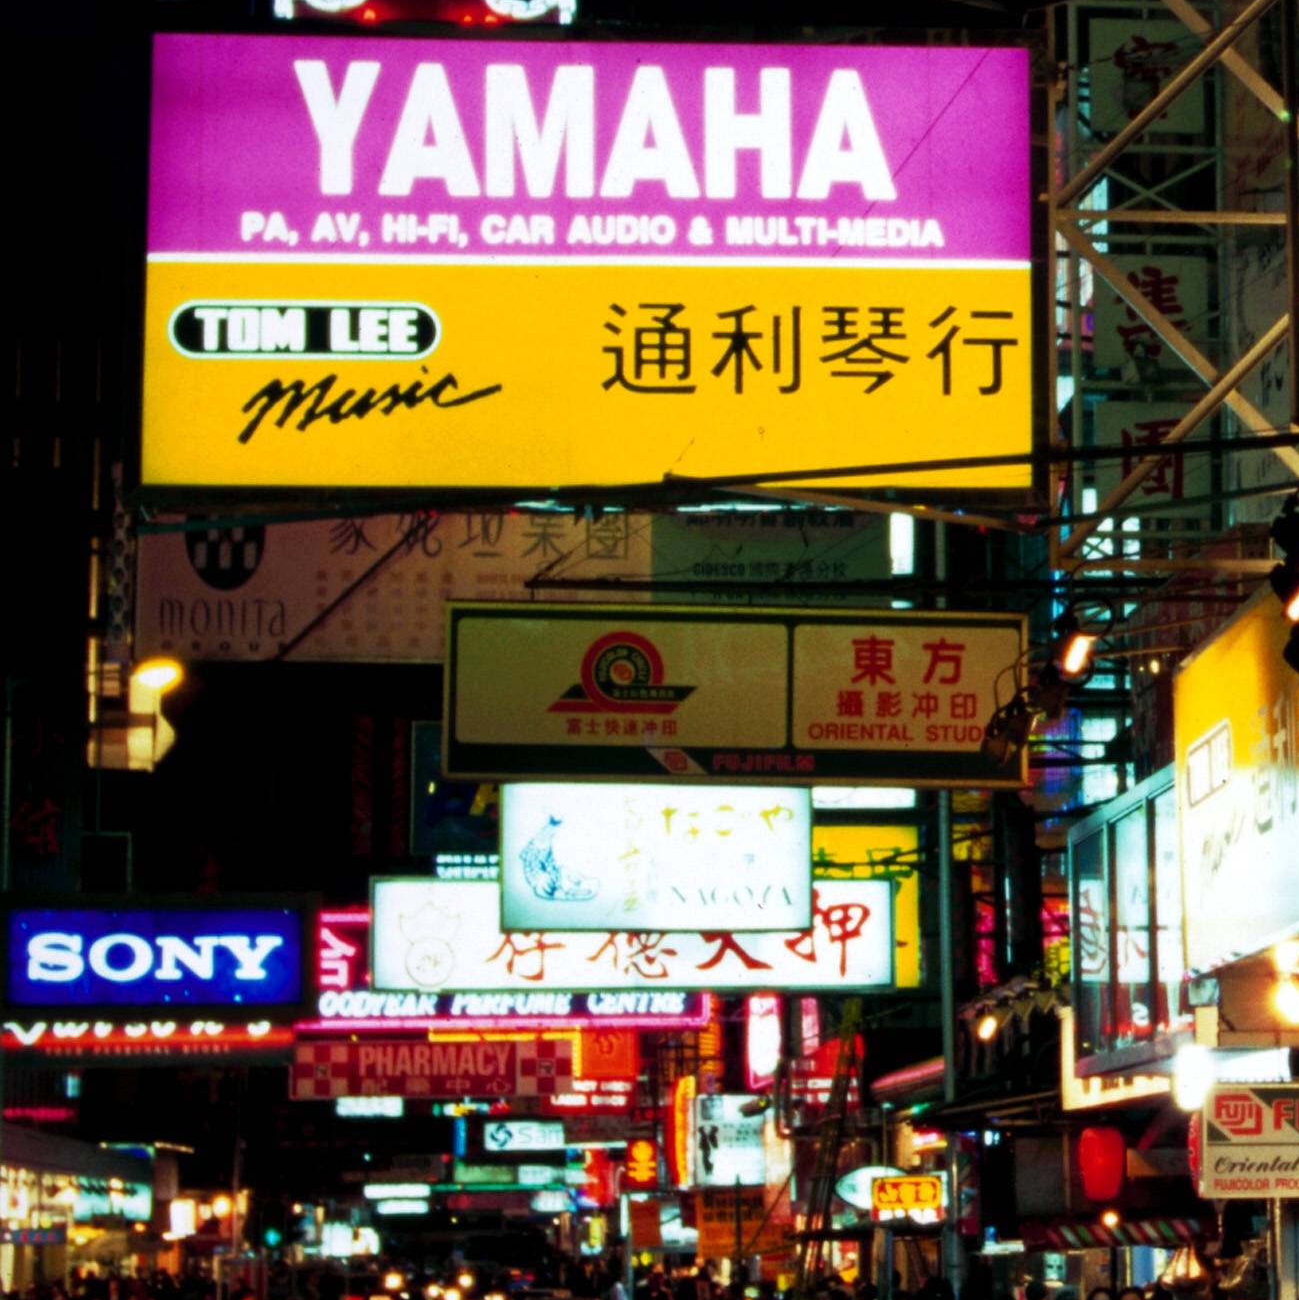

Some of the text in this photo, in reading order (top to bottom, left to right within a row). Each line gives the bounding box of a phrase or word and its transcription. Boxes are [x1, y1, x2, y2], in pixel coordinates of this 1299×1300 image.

[292, 58, 897, 201] YAMAHA
[239, 212, 946, 249] PA, AV, HI-FI, CAR AUDIO & MULTI-MEDIA
[193, 307, 420, 354] TOM LEE
[600, 301, 1020, 398] 通利琴行
[237, 365, 502, 446] Music
[850, 634, 967, 686] 東方
[807, 722, 982, 743] ORIENTAL STUD
[711, 753, 815, 772] FUJIFILM
[27, 932, 284, 982] SONY
[587, 992, 686, 1014] CENTRE
[358, 1042, 514, 1078] PHARMACY
[1214, 1177, 1269, 1191] FUJICOLOR
